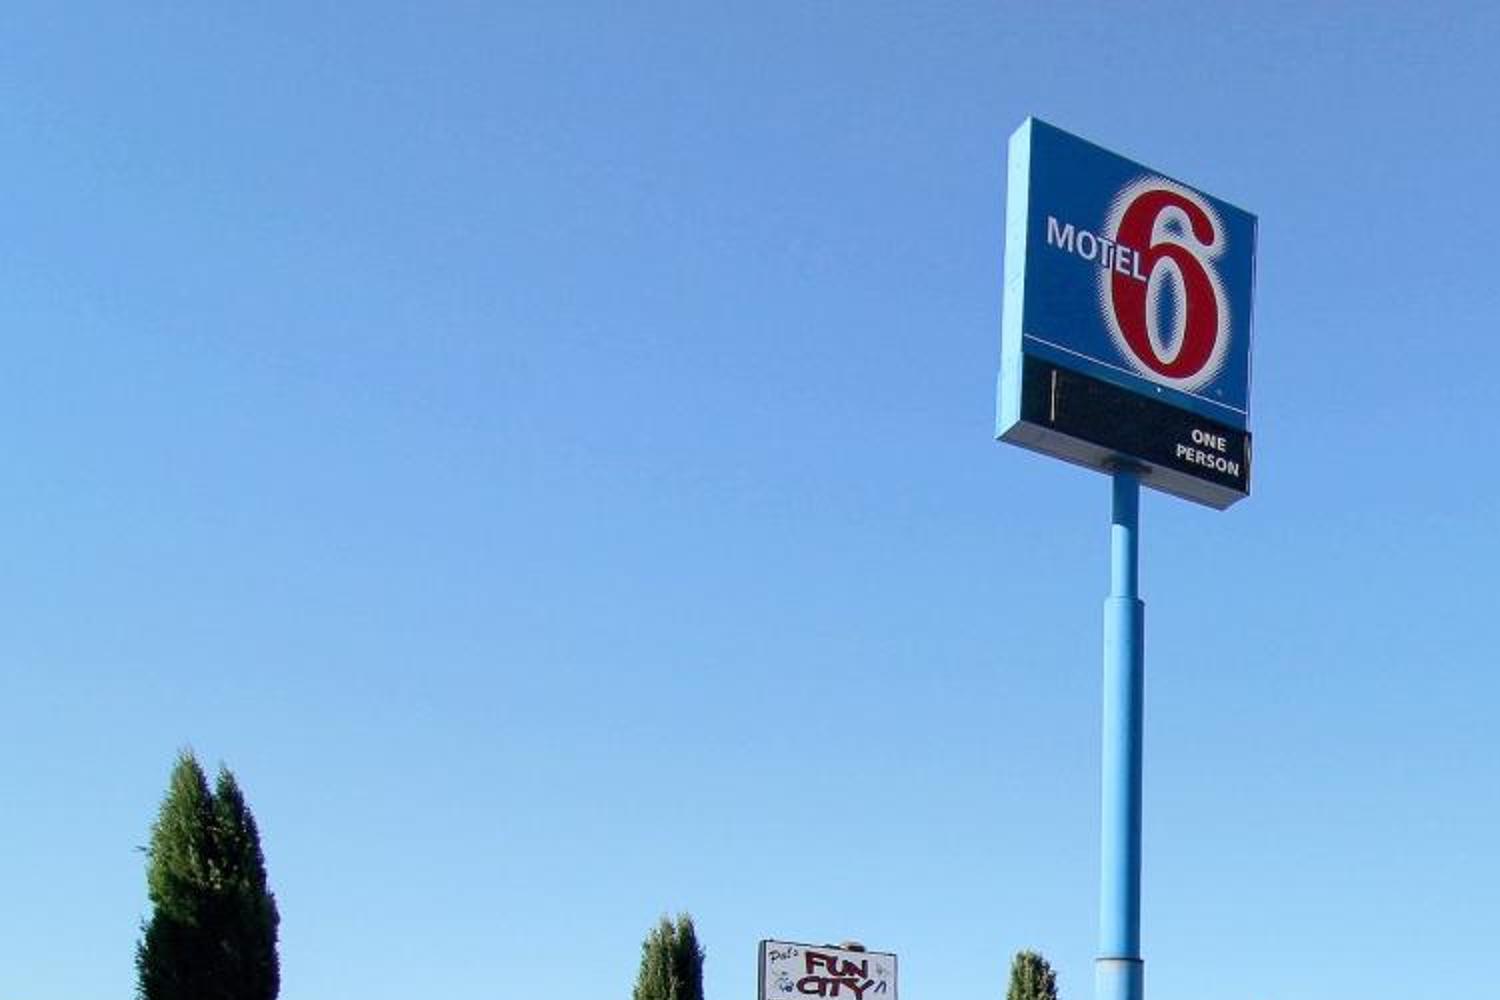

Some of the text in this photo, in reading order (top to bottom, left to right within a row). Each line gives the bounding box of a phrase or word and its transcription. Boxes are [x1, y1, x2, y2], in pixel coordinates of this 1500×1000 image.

[1046, 188, 1219, 379] MOTEL 6
[1191, 428, 1227, 453] ONE
[1176, 443, 1239, 477] PERSON
[805, 950, 868, 979] FUN
